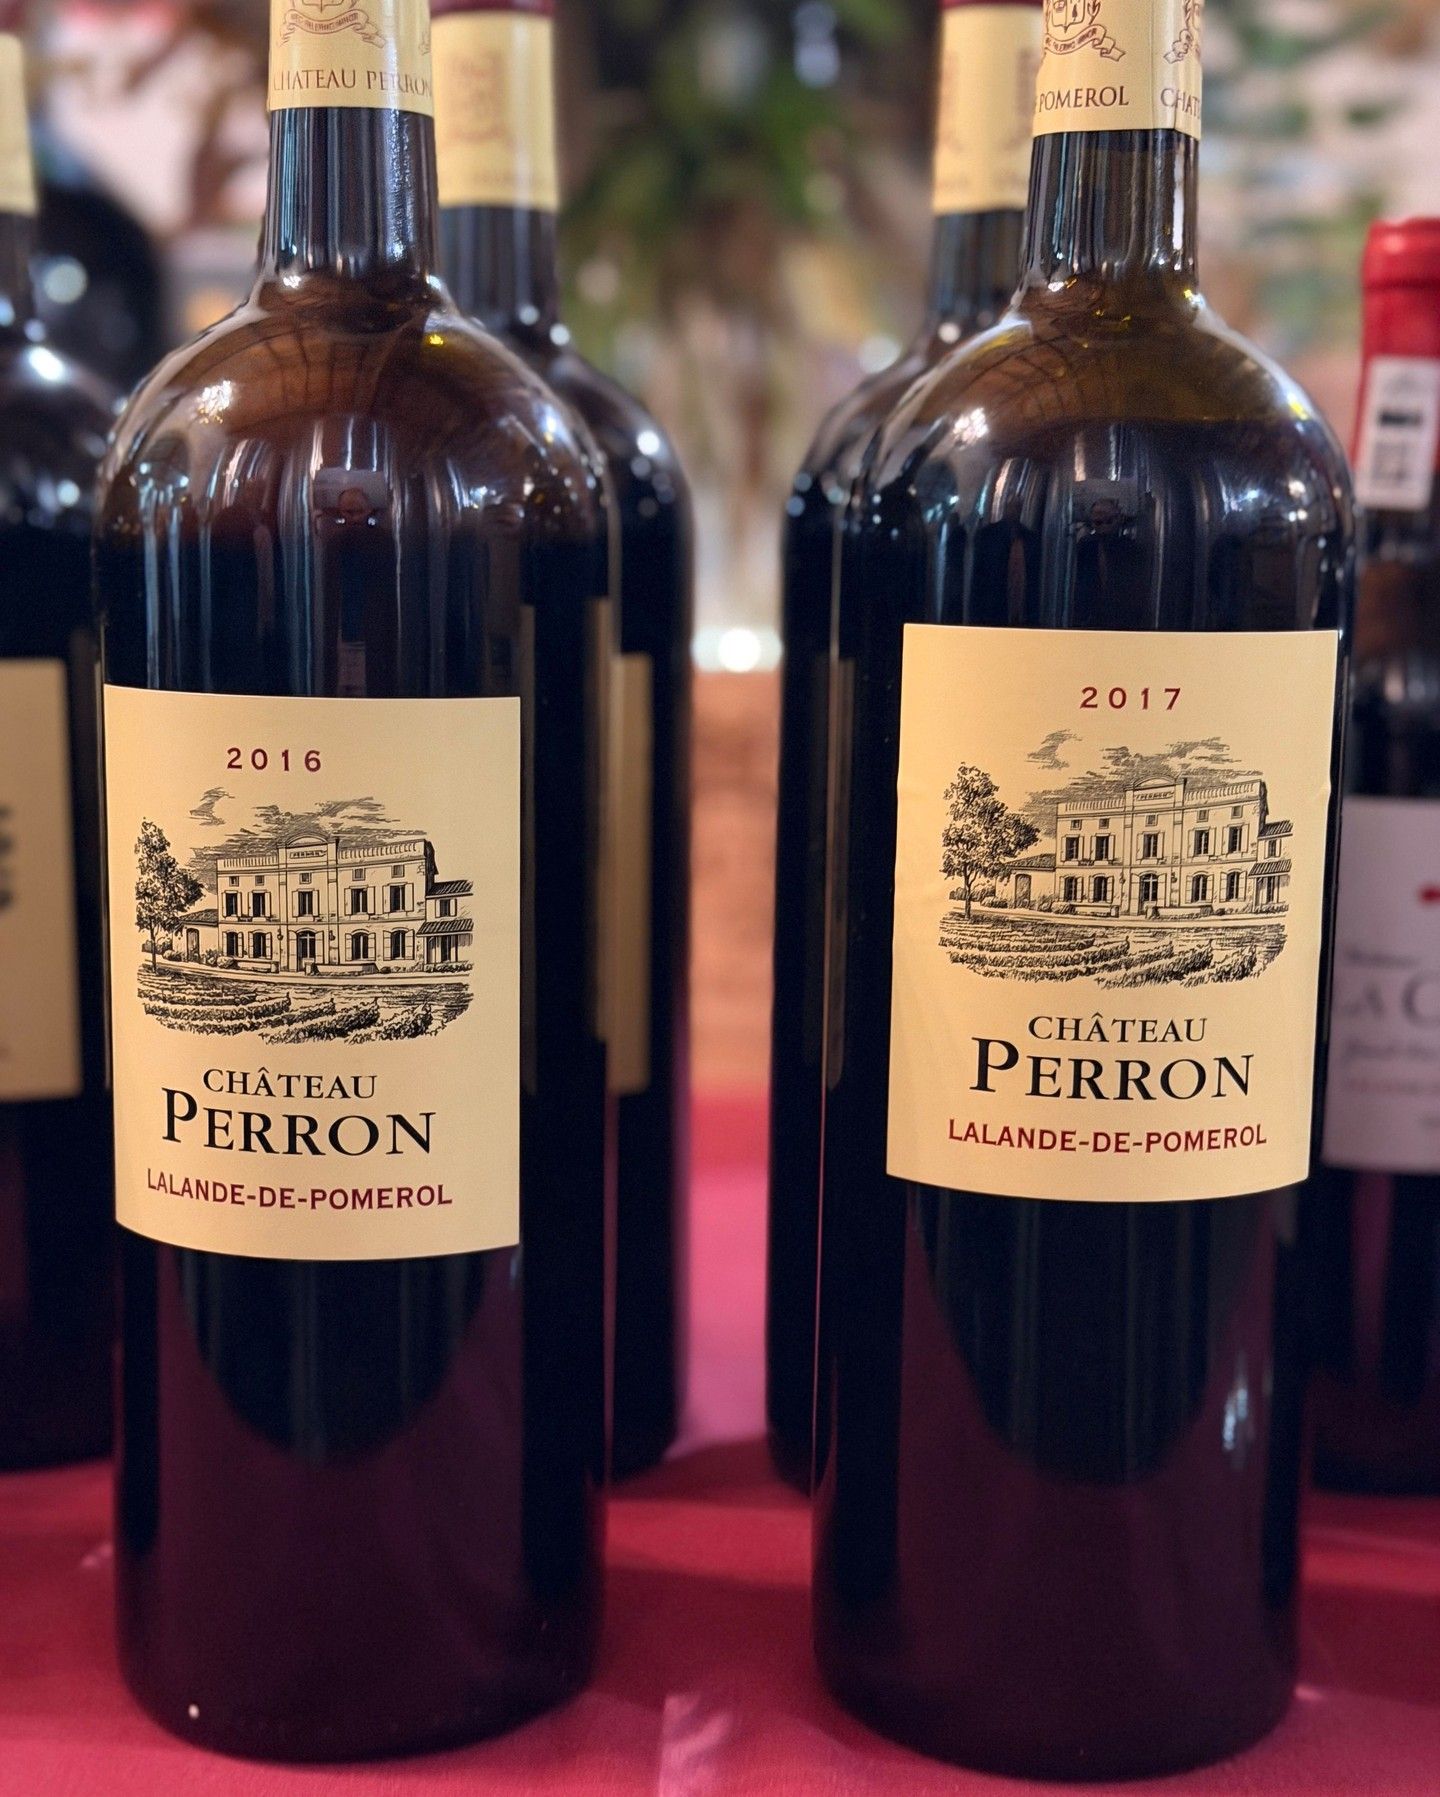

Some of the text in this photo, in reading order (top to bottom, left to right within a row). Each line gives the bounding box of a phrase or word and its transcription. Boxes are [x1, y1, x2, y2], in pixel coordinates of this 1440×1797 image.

[1038, 85, 1129, 112] POMEROL
[1080, 687, 1181, 710] 2017
[226, 747, 322, 773] 2016
[1028, 1012, 1207, 1043] CHÂTEAU
[203, 1066, 377, 1099] CHÂTEAU
[969, 1036, 1255, 1101] PERRON
[161, 1086, 437, 1157] PERRON
[948, 1118, 1267, 1154] LALANDE-DE-POMEROL
[147, 1167, 453, 1210] LALANDE-DE-POMEROL
